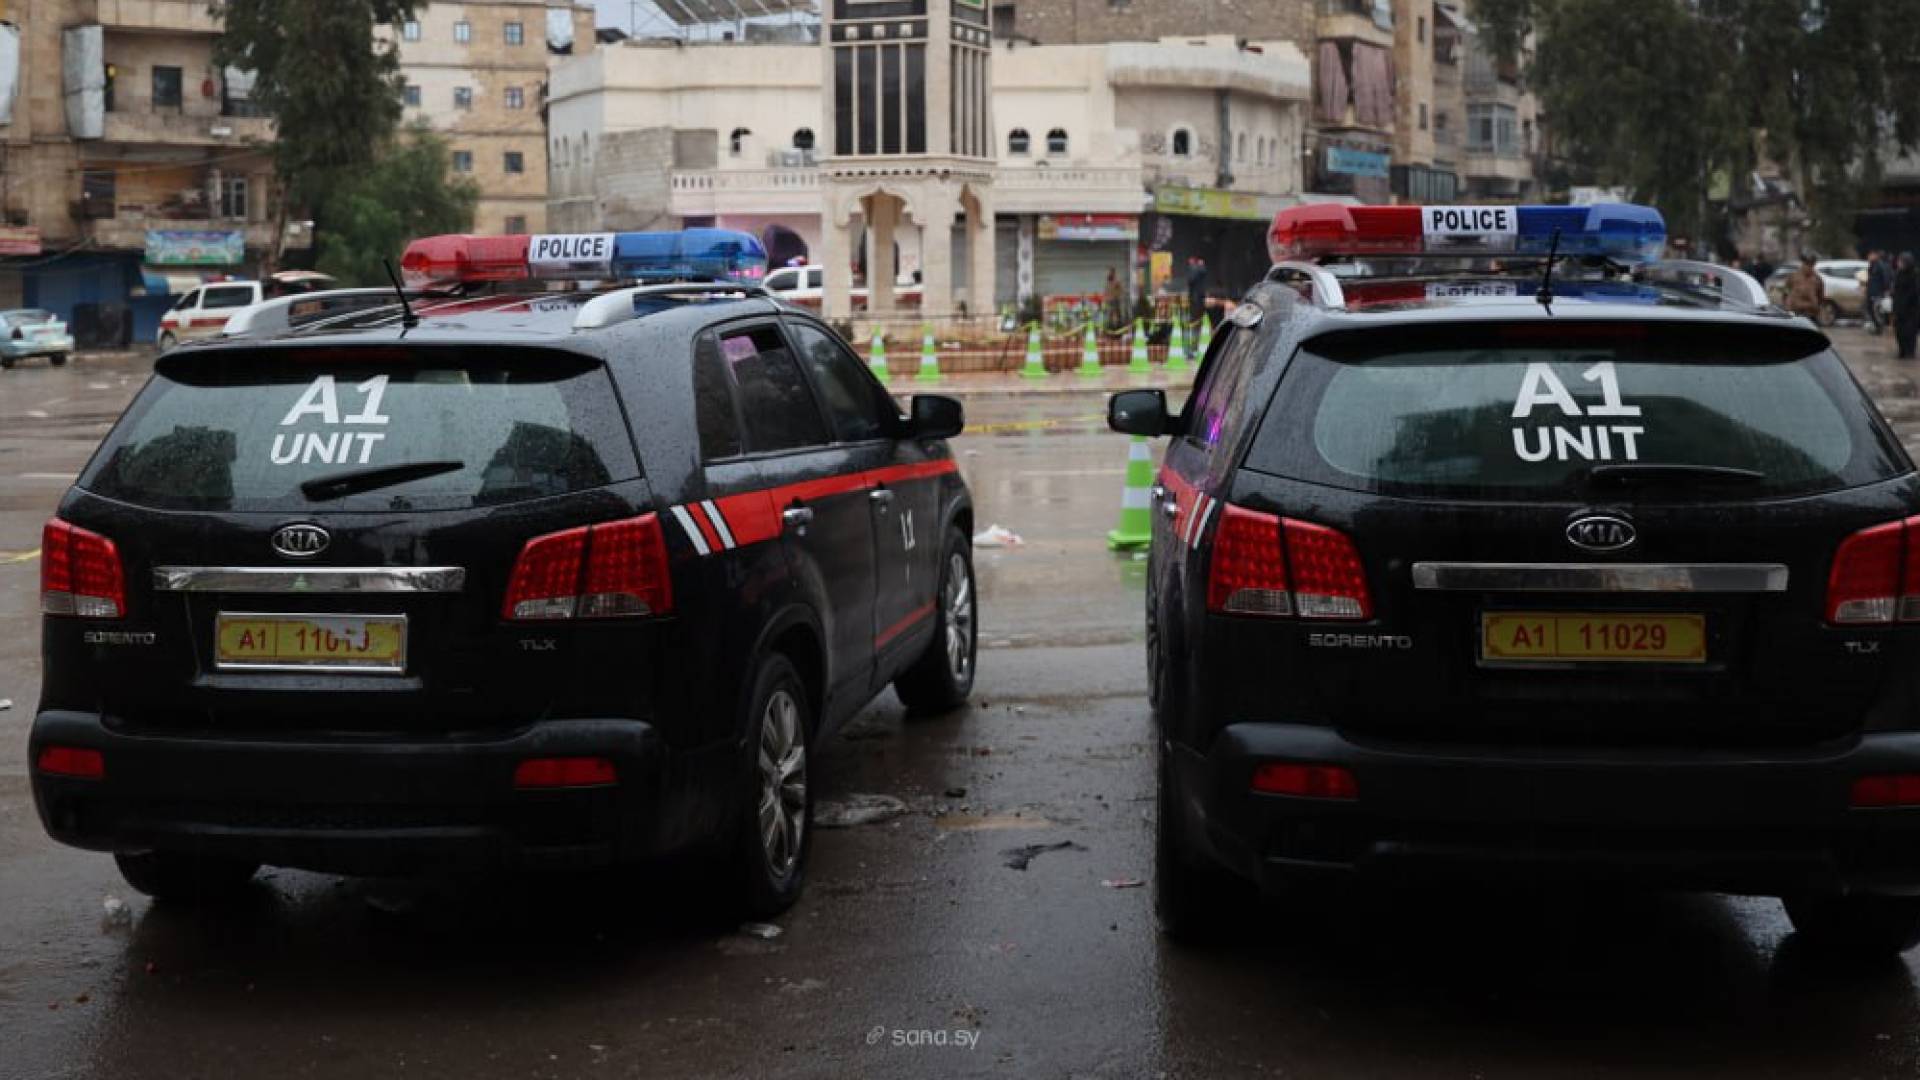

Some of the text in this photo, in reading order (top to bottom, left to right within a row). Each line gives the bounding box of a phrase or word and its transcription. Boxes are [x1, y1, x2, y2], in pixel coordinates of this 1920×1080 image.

[1432, 209, 1508, 231] POLICE
[537, 237, 604, 258] POLICE
[280, 374, 390, 426] A1
[1511, 361, 1642, 418] A1
[270, 431, 386, 465] UNIT
[1512, 425, 1644, 462] UNIT
[280, 528, 322, 551] KIA
[1576, 522, 1626, 545] KIA
[238, 628, 267, 650] A1
[1309, 633, 1412, 649] SORENTO
[1511, 623, 1667, 650] A1 11029
